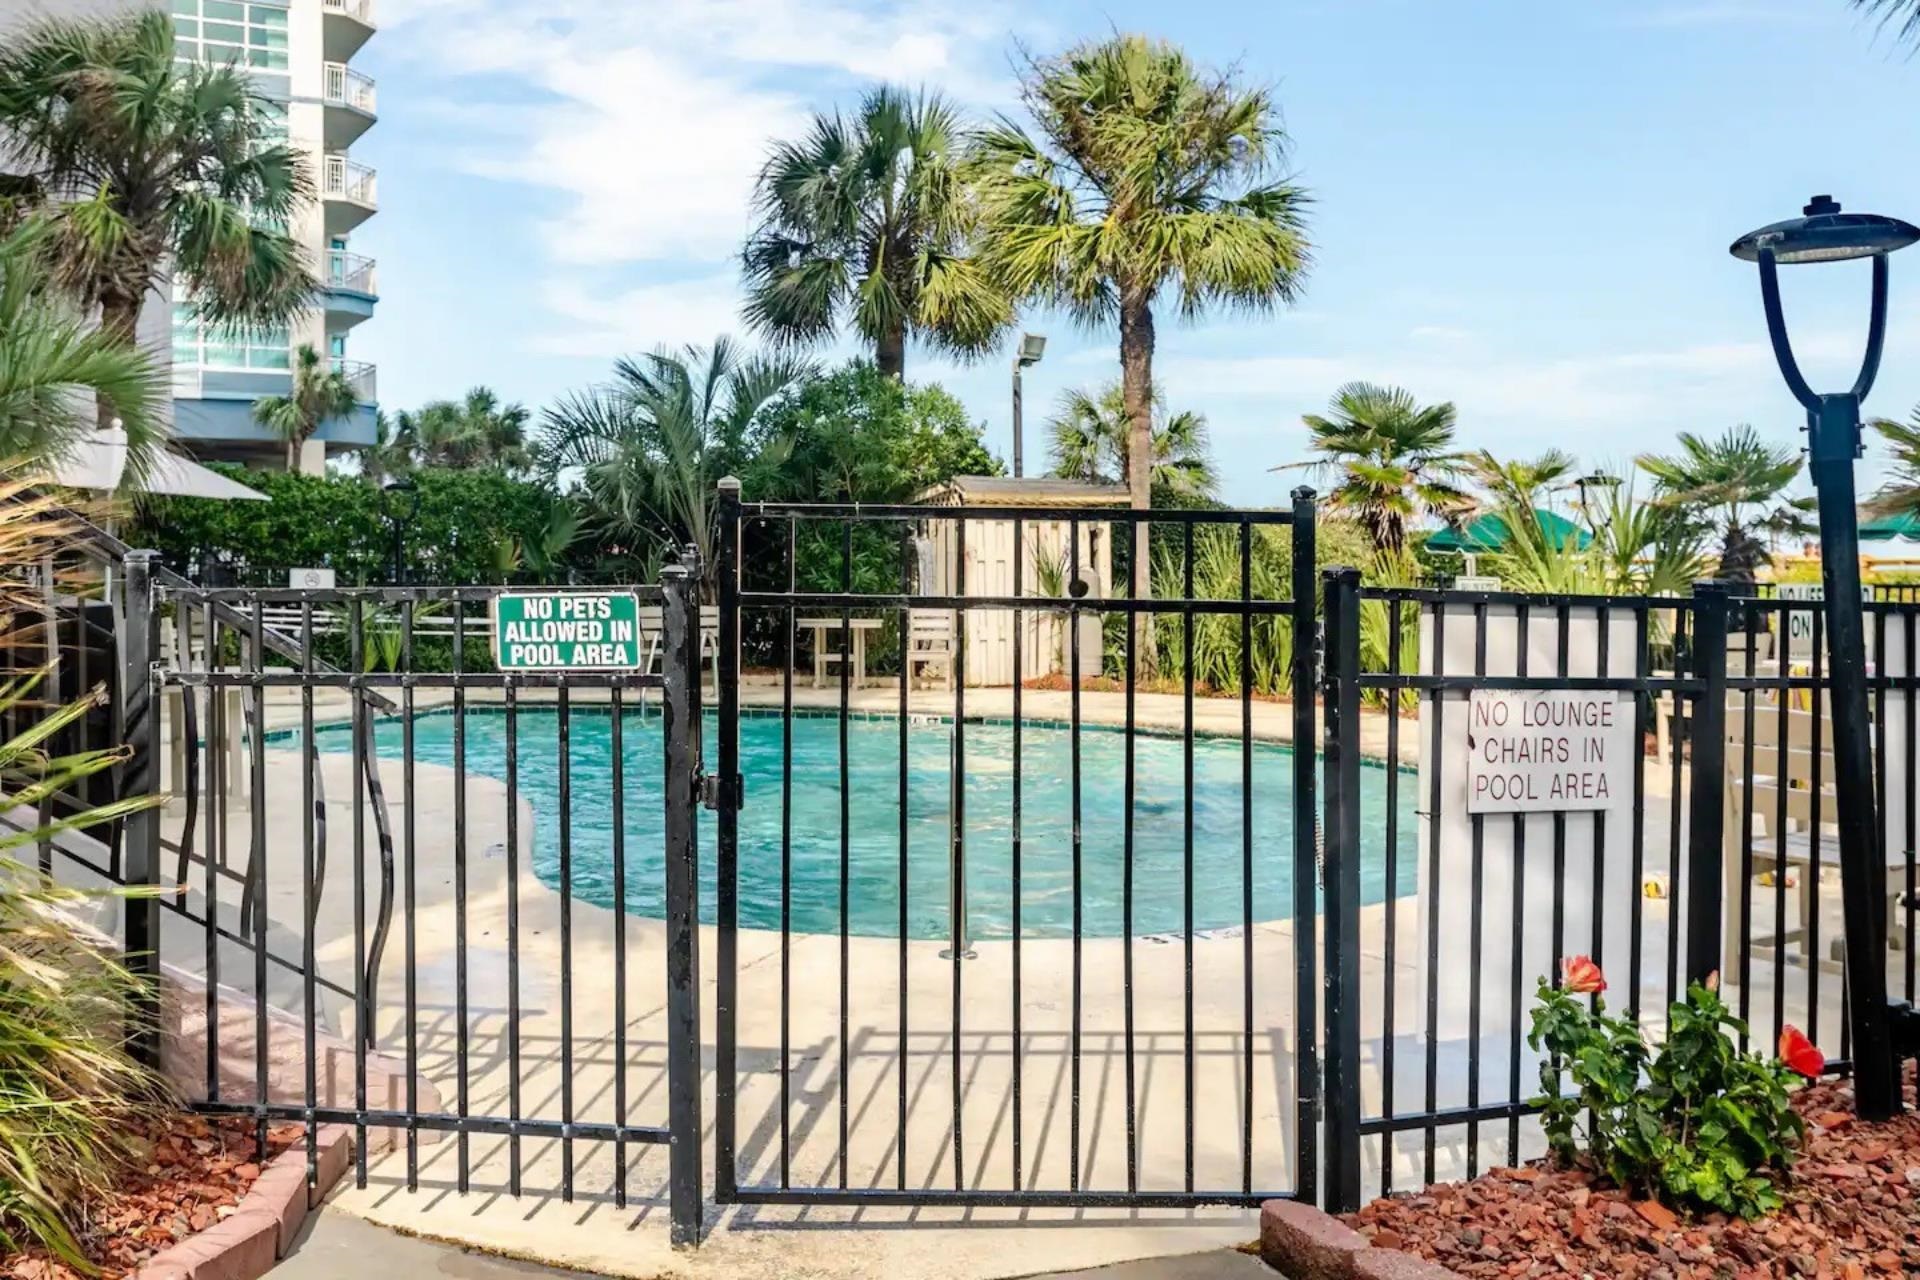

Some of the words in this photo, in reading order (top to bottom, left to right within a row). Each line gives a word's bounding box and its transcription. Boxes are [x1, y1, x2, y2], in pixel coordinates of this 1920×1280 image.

[523, 598, 552, 619] NO
[559, 598, 611, 618] PETS
[505, 621, 603, 642] ALLOWED
[610, 621, 632, 641] IN
[1791, 615, 1810, 638] ON
[510, 644, 564, 665] POOL
[571, 644, 629, 665] AREA
[1475, 701, 1509, 727] NO
[1523, 701, 1613, 727] LOUNGE
[1484, 737, 1569, 764] CHAIRS
[1583, 737, 1604, 762] IN
[1476, 774, 1536, 800] POOL
[1550, 773, 1609, 799] AREA
